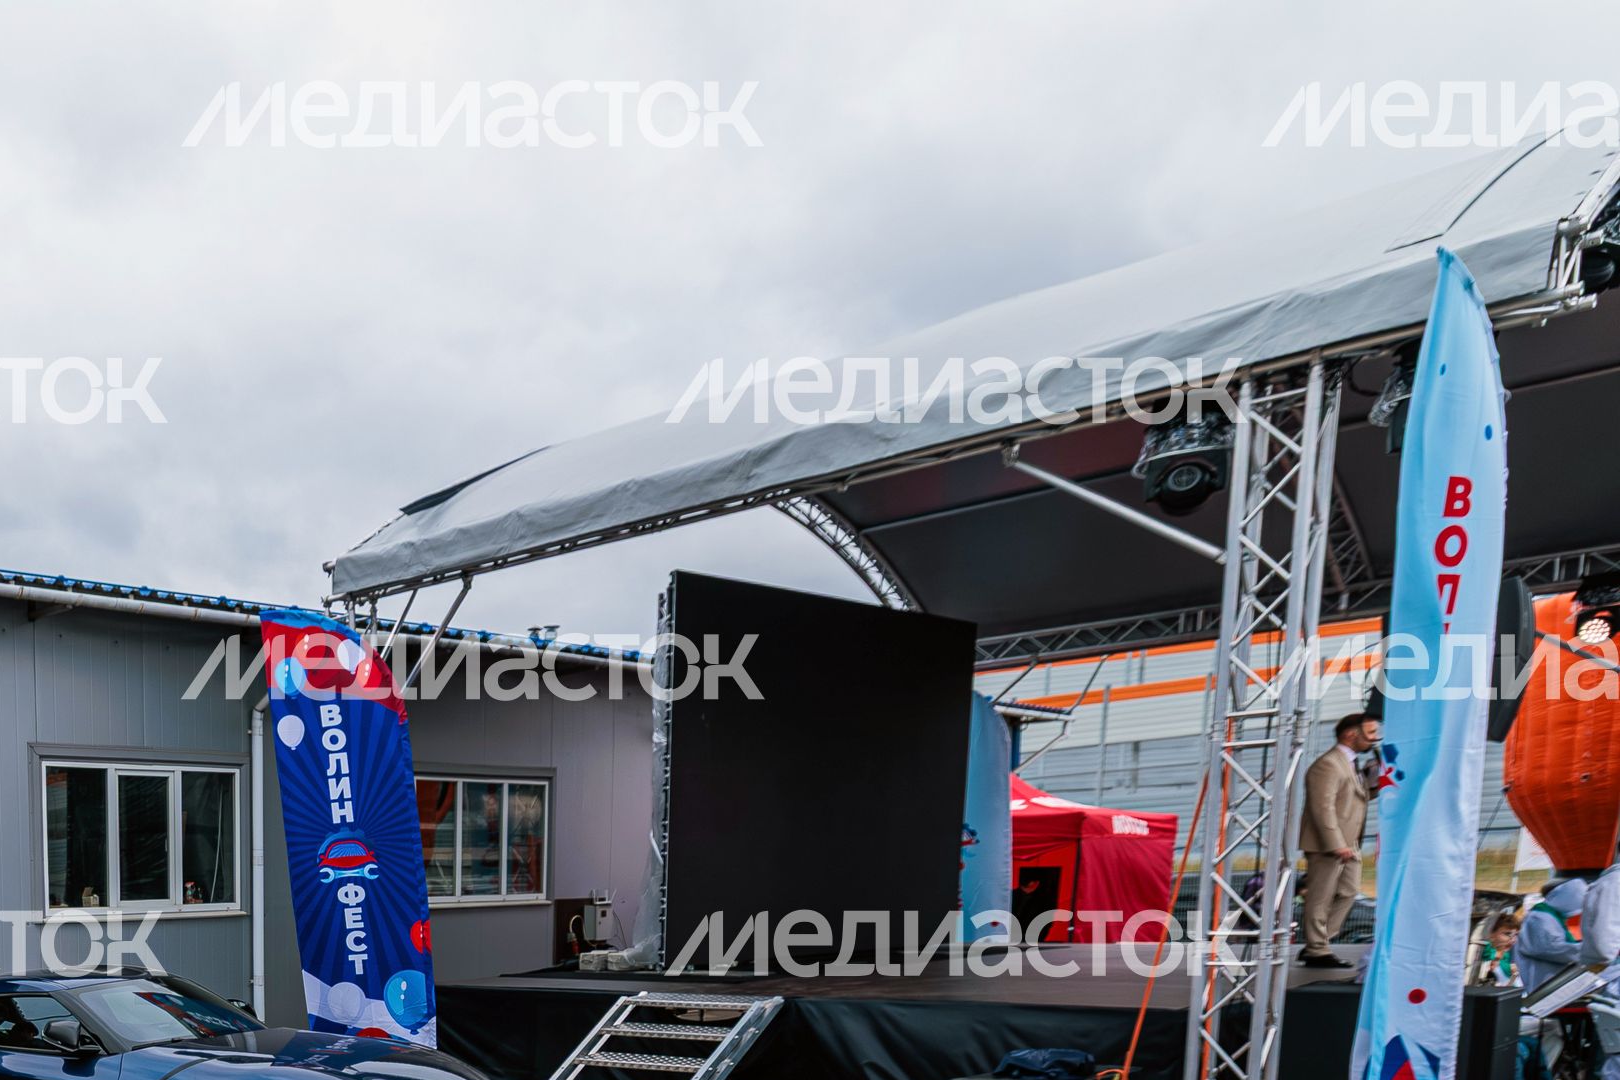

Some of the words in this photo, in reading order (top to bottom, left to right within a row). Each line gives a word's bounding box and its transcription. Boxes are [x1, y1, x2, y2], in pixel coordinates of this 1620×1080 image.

[1433, 476, 1473, 632] ВОЛ
[320, 704, 354, 824] ВОЛИН
[337, 883, 369, 975] ФЕСТ
